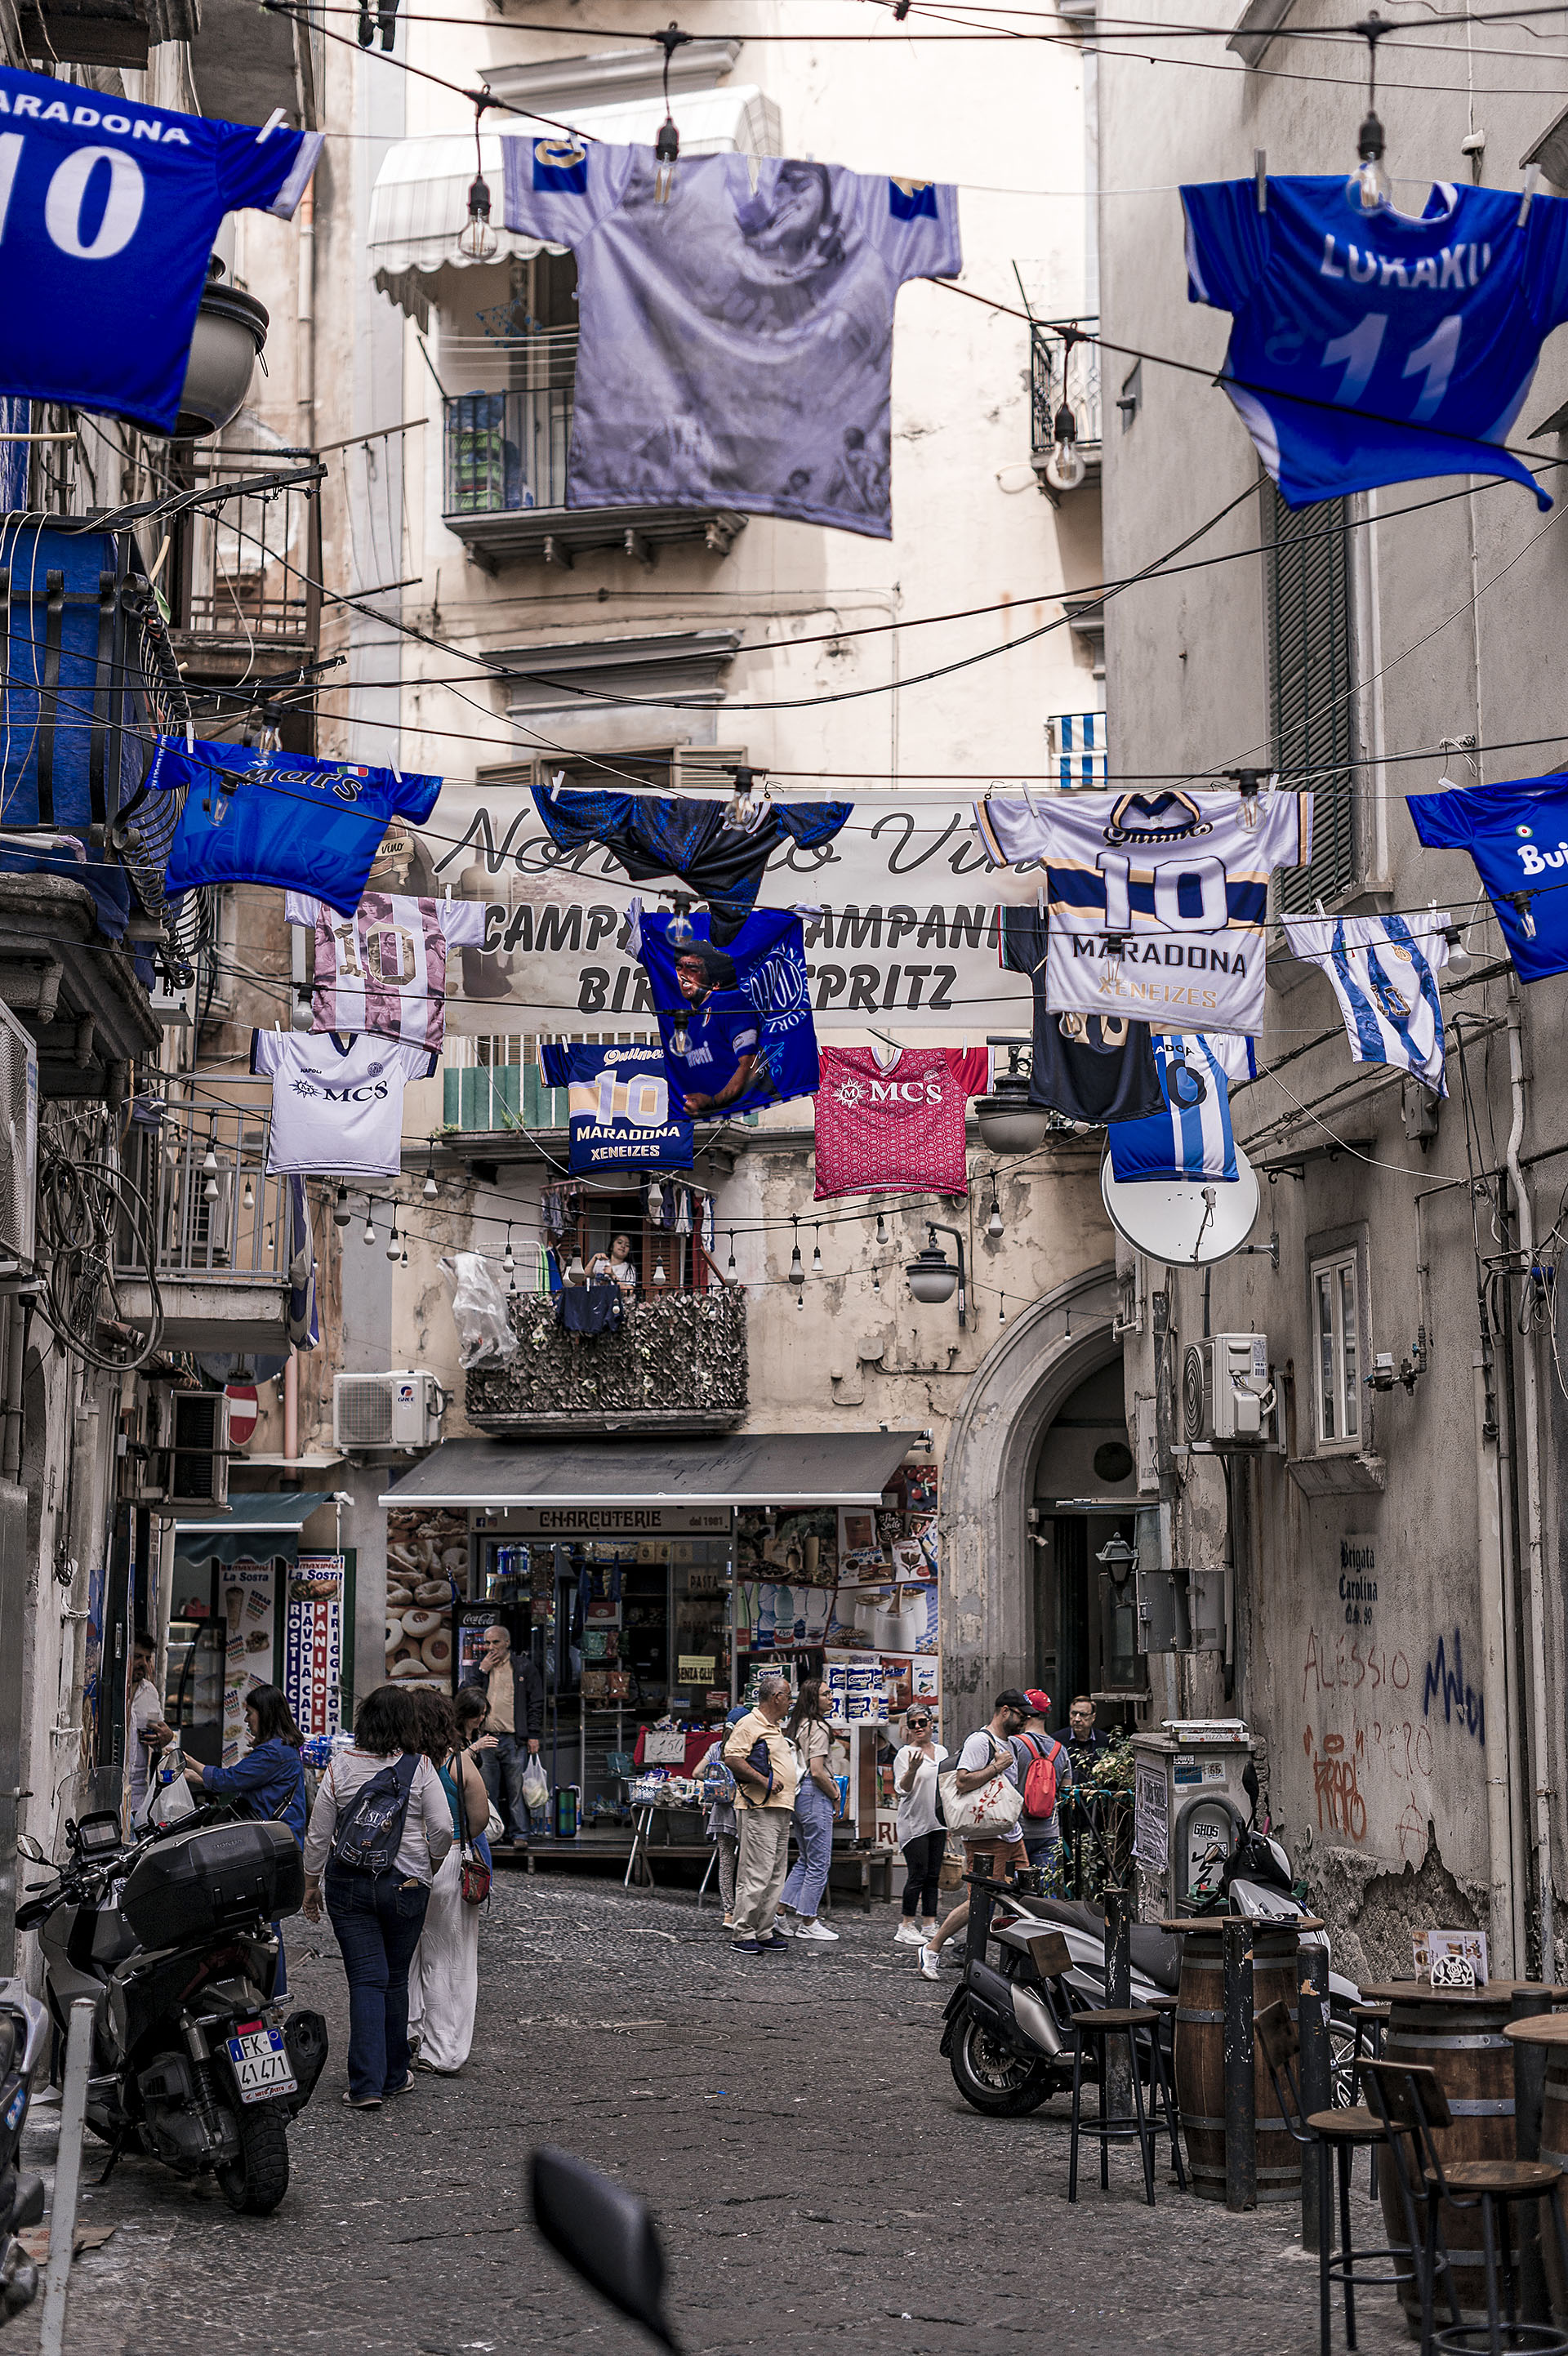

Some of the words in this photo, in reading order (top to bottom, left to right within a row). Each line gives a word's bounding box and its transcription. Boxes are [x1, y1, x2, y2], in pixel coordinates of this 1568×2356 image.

[1320, 313, 1463, 421] 11
[1095, 851, 1229, 936] 10
[333, 921, 417, 986] 10
[807, 964, 959, 1014] PRITZ
[1098, 976, 1218, 1009] XENEIZES
[1370, 984, 1412, 1018] 10
[322, 1080, 390, 1102] MCS
[595, 1069, 670, 1128] 10
[869, 1080, 944, 1105] MCS
[577, 1125, 681, 1142] MARADONA
[590, 1144, 661, 1161] XENEIZES
[540, 1510, 662, 1530] CHARCUTERIE
[1340, 1540, 1375, 1574] Brigata
[223, 1572, 236, 1582] La
[287, 1570, 303, 1581] La
[690, 1575, 719, 1589] PASTA
[1339, 1573, 1379, 1601] Carolina
[301, 1602, 314, 1679] TAVOLA
[239, 2034, 264, 2058] FK
